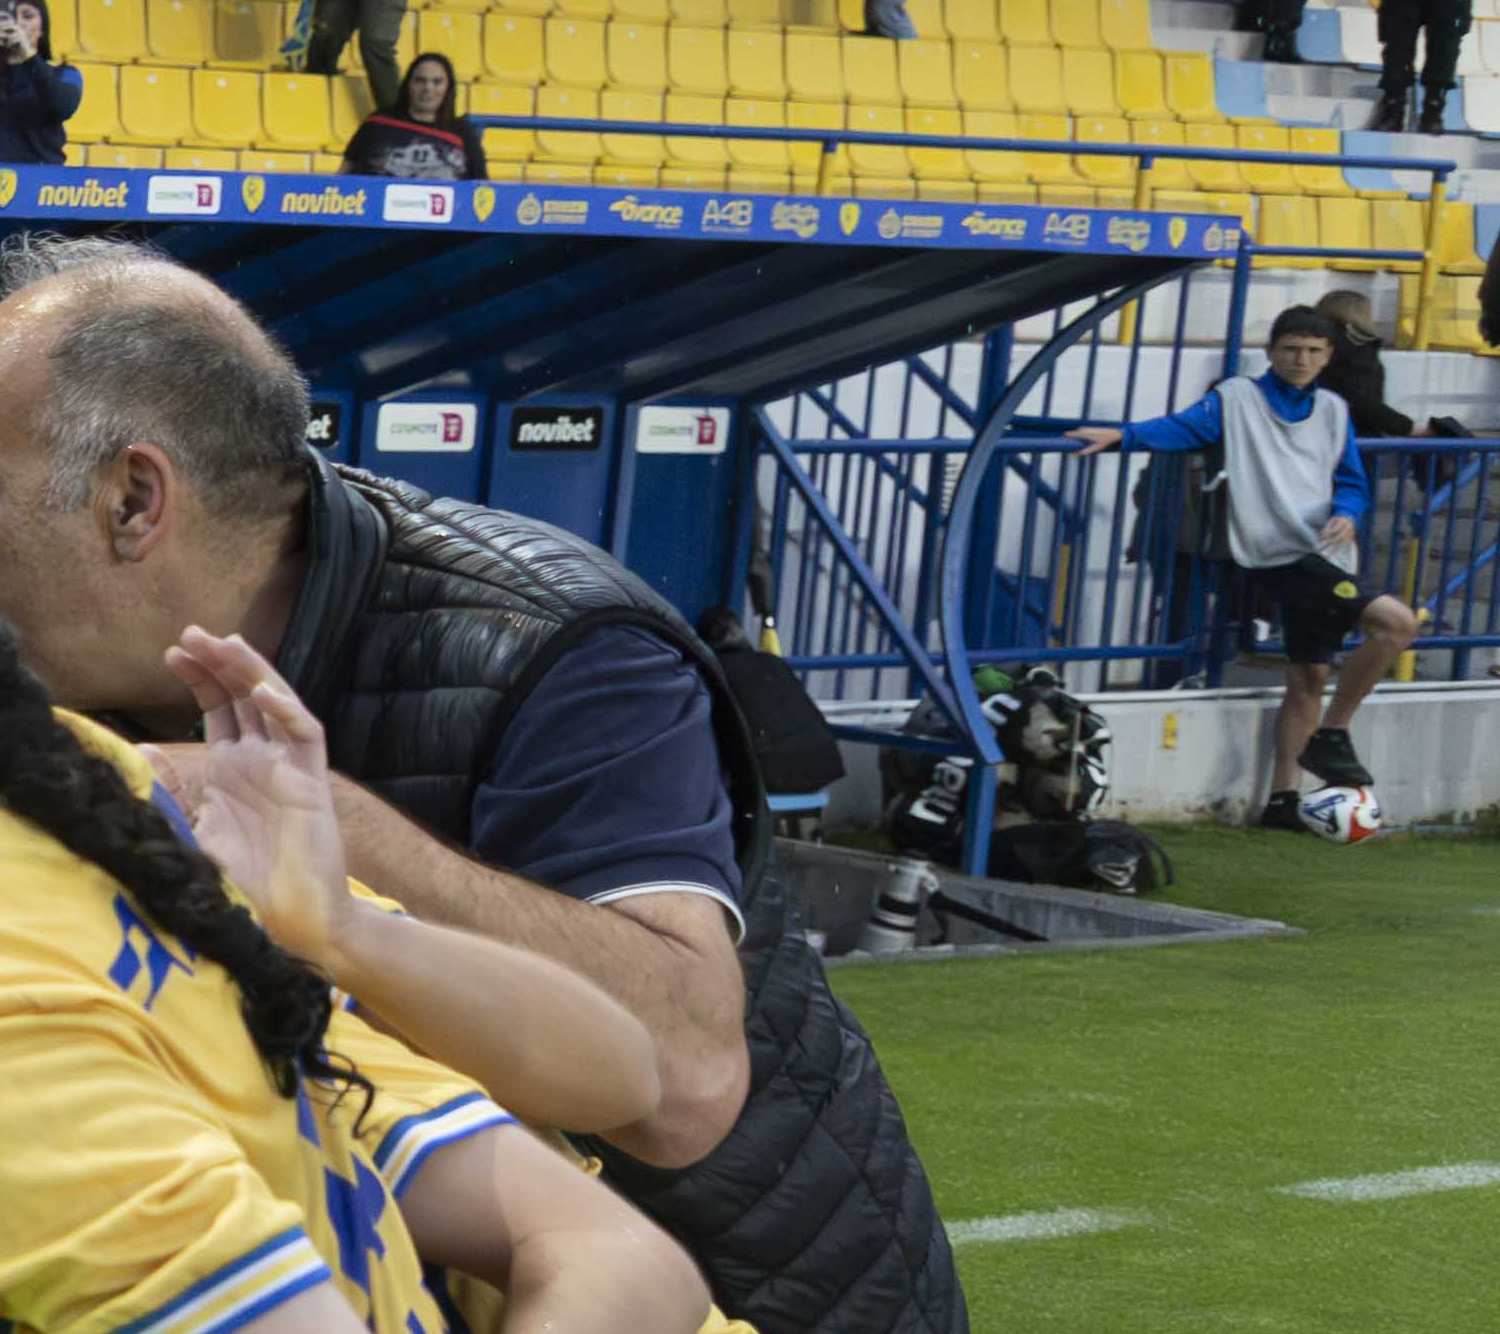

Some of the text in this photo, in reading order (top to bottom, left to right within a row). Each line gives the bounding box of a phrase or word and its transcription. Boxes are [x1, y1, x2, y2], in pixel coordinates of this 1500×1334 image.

[38, 179, 127, 208] novibet
[281, 187, 367, 215] novibet
[518, 416, 595, 442] novibet
